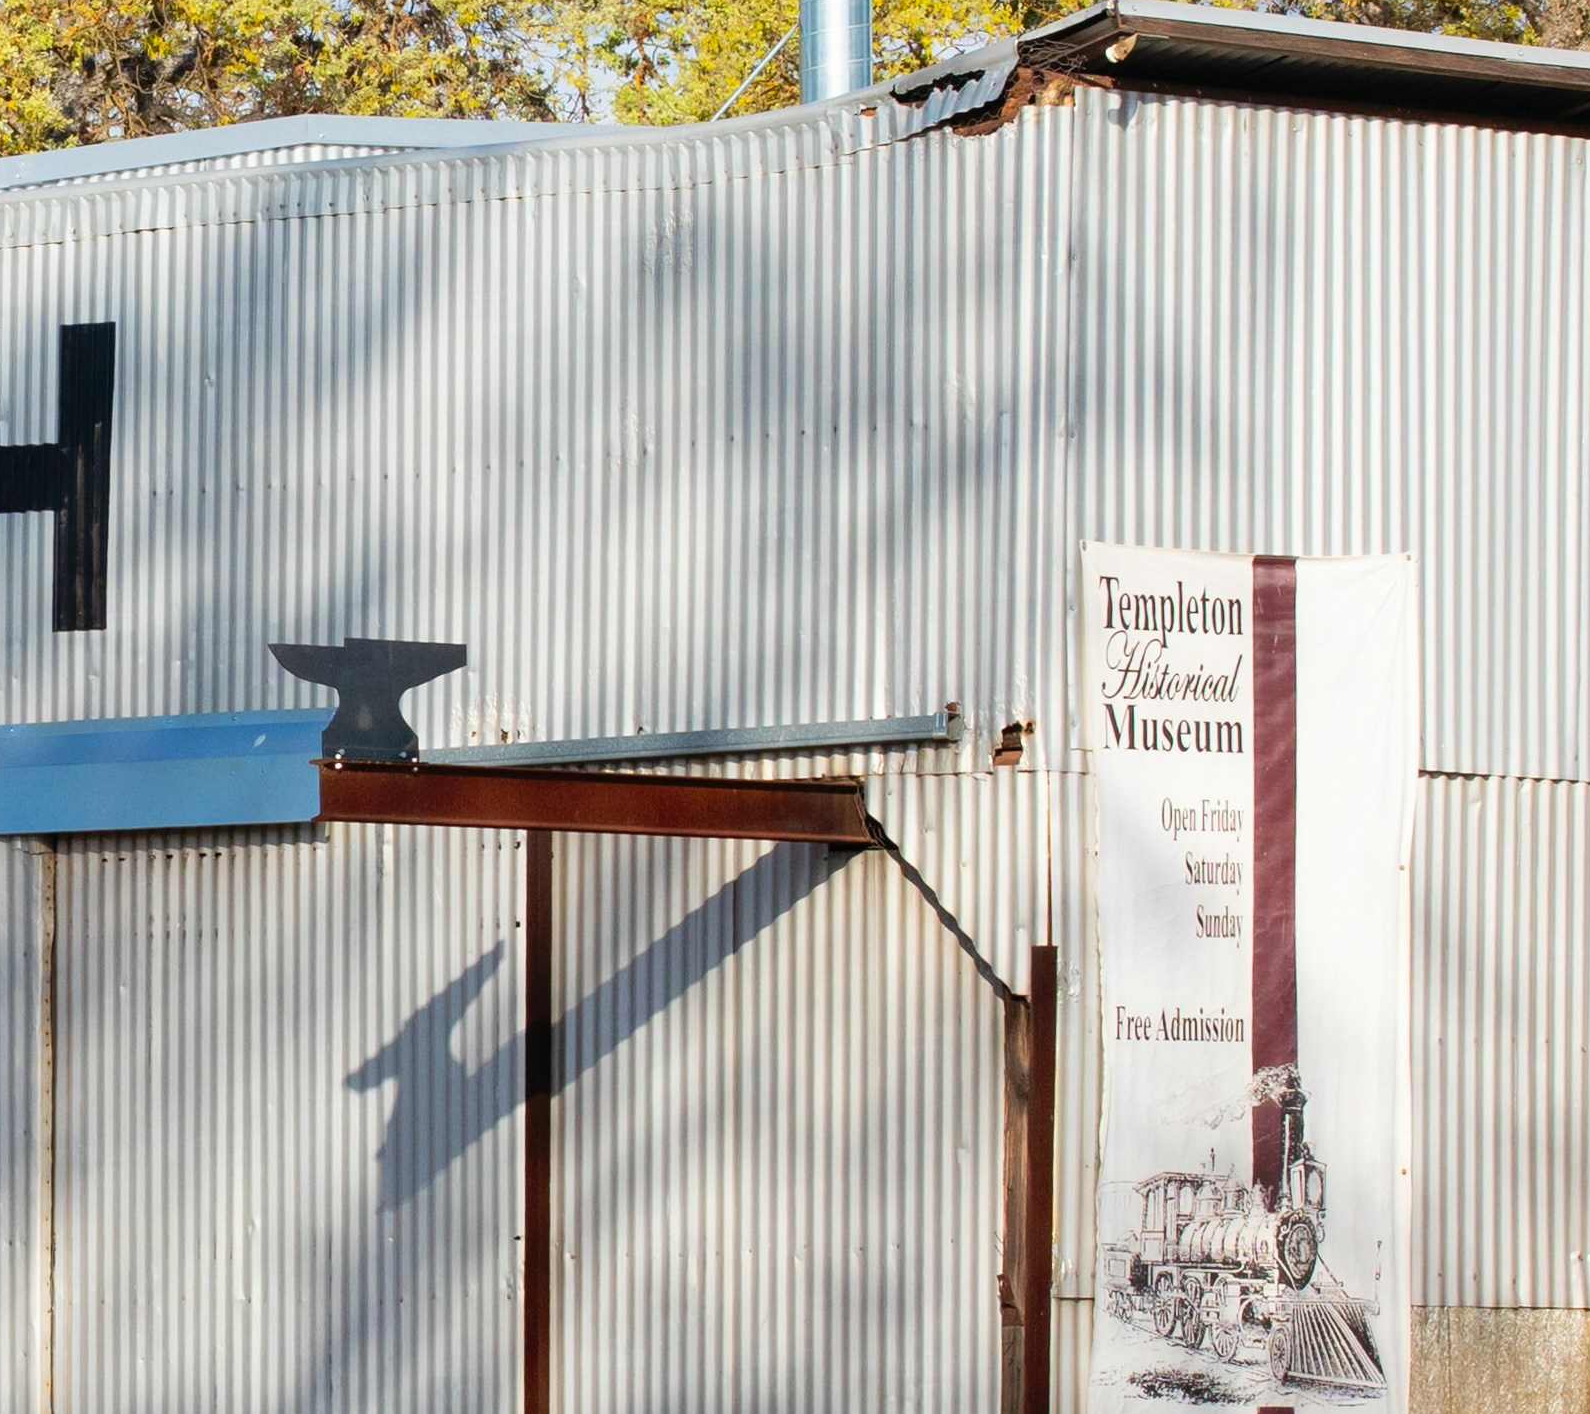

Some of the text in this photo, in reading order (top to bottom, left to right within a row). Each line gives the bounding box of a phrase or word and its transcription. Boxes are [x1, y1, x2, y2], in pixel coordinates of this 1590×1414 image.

[1099, 575, 1244, 648] Templeton
[1101, 630, 1244, 703] Historical
[1102, 703, 1244, 754] Museum
[1161, 797, 1245, 843] Open Friday
[1184, 853, 1244, 895] Saturday
[1195, 904, 1244, 948] Sunday
[1115, 1005, 1245, 1043] Free Admission
